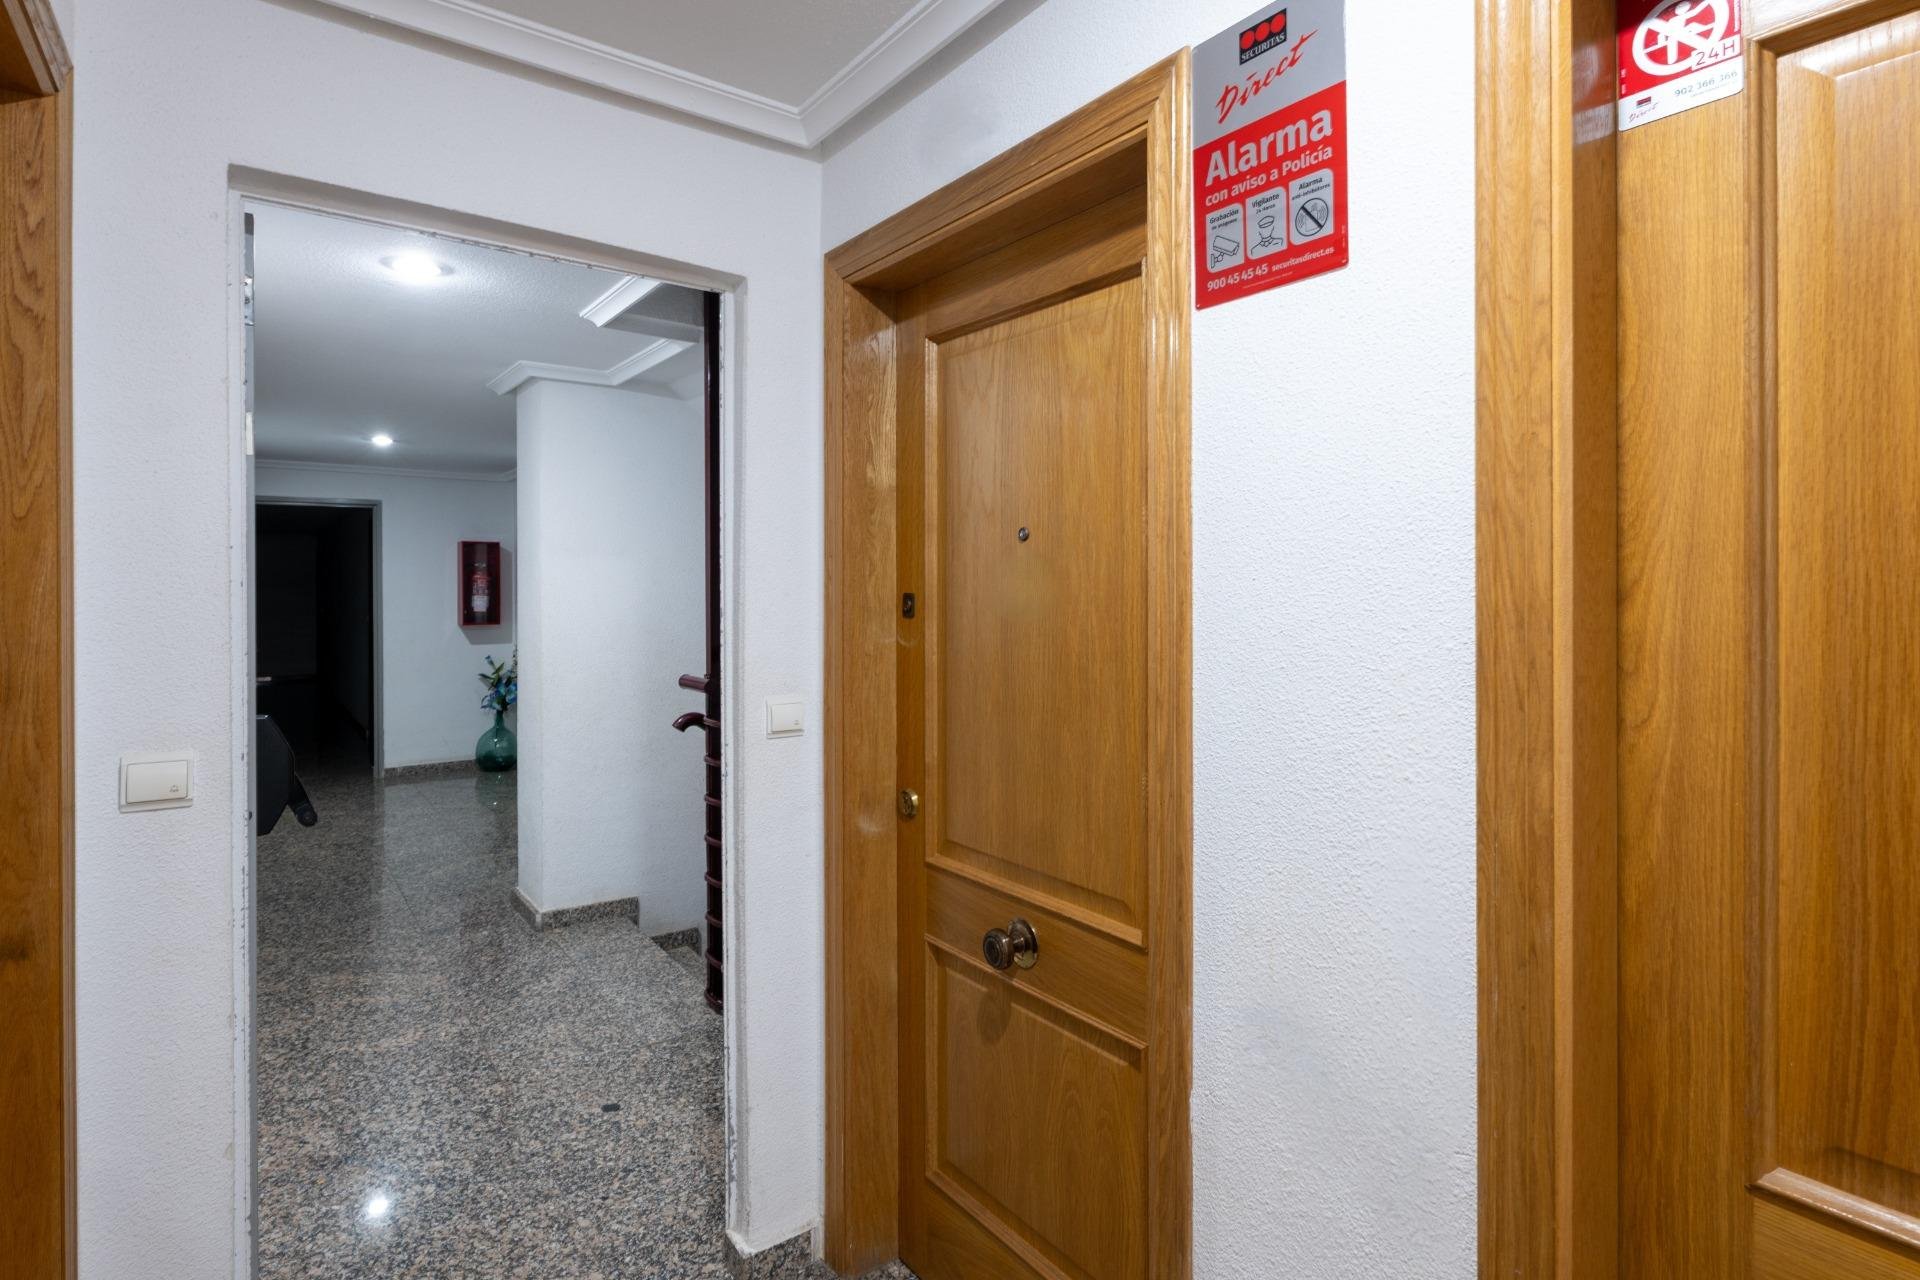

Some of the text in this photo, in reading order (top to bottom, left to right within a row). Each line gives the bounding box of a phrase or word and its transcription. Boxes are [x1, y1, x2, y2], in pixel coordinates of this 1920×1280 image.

[1241, 33, 1285, 61] SECURITAS
[1695, 40, 1735, 66] 24H
[1215, 29, 1319, 124] Direct
[1674, 84, 1694, 97] 902
[1697, 78, 1715, 90] 166
[1205, 109, 1333, 187] Alarma
[1205, 145, 1333, 207] con aviso a Policía
[1298, 176, 1323, 190] Alarma
[1251, 193, 1280, 209] Vigilante
[1209, 208, 1240, 225] Grabación
[1207, 278, 1226, 292] 900
[1227, 272, 1240, 285] 45
[1241, 267, 1255, 280] 45
[1255, 263, 1269, 276] 45
[1271, 246, 1335, 272] securitasdirect.es
